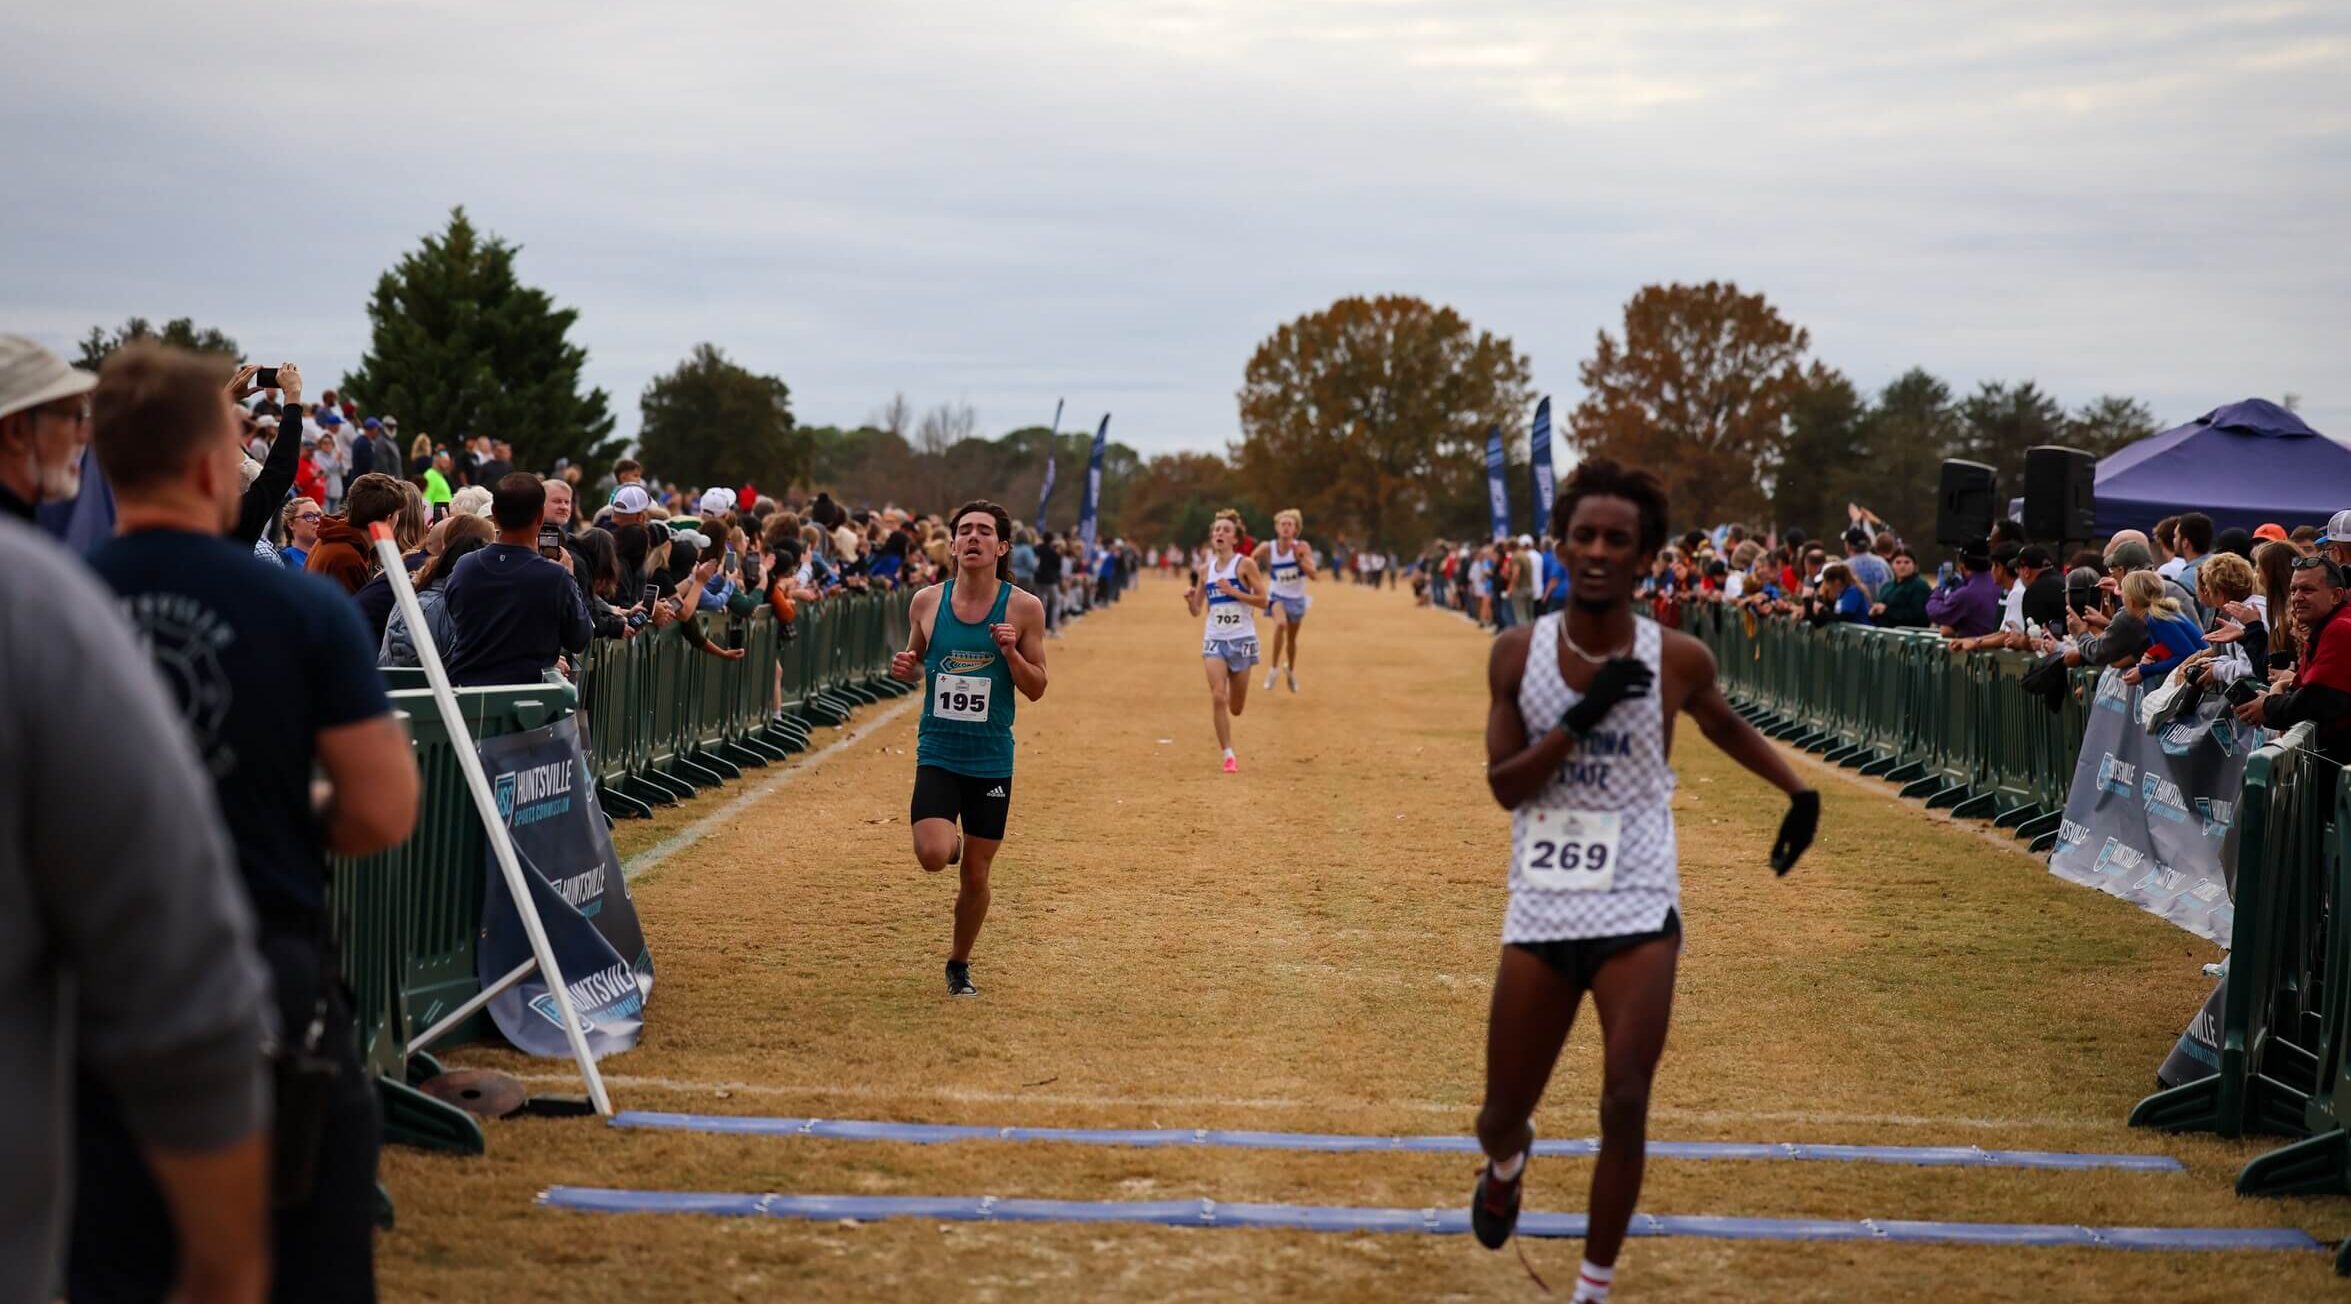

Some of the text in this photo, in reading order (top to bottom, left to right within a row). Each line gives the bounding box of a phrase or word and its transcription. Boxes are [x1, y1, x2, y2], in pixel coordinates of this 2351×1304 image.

[1217, 615, 1240, 624] 702
[940, 692, 985, 713] 195
[516, 759, 573, 806] HUNTSVILLE
[1530, 841, 1608, 871] 269
